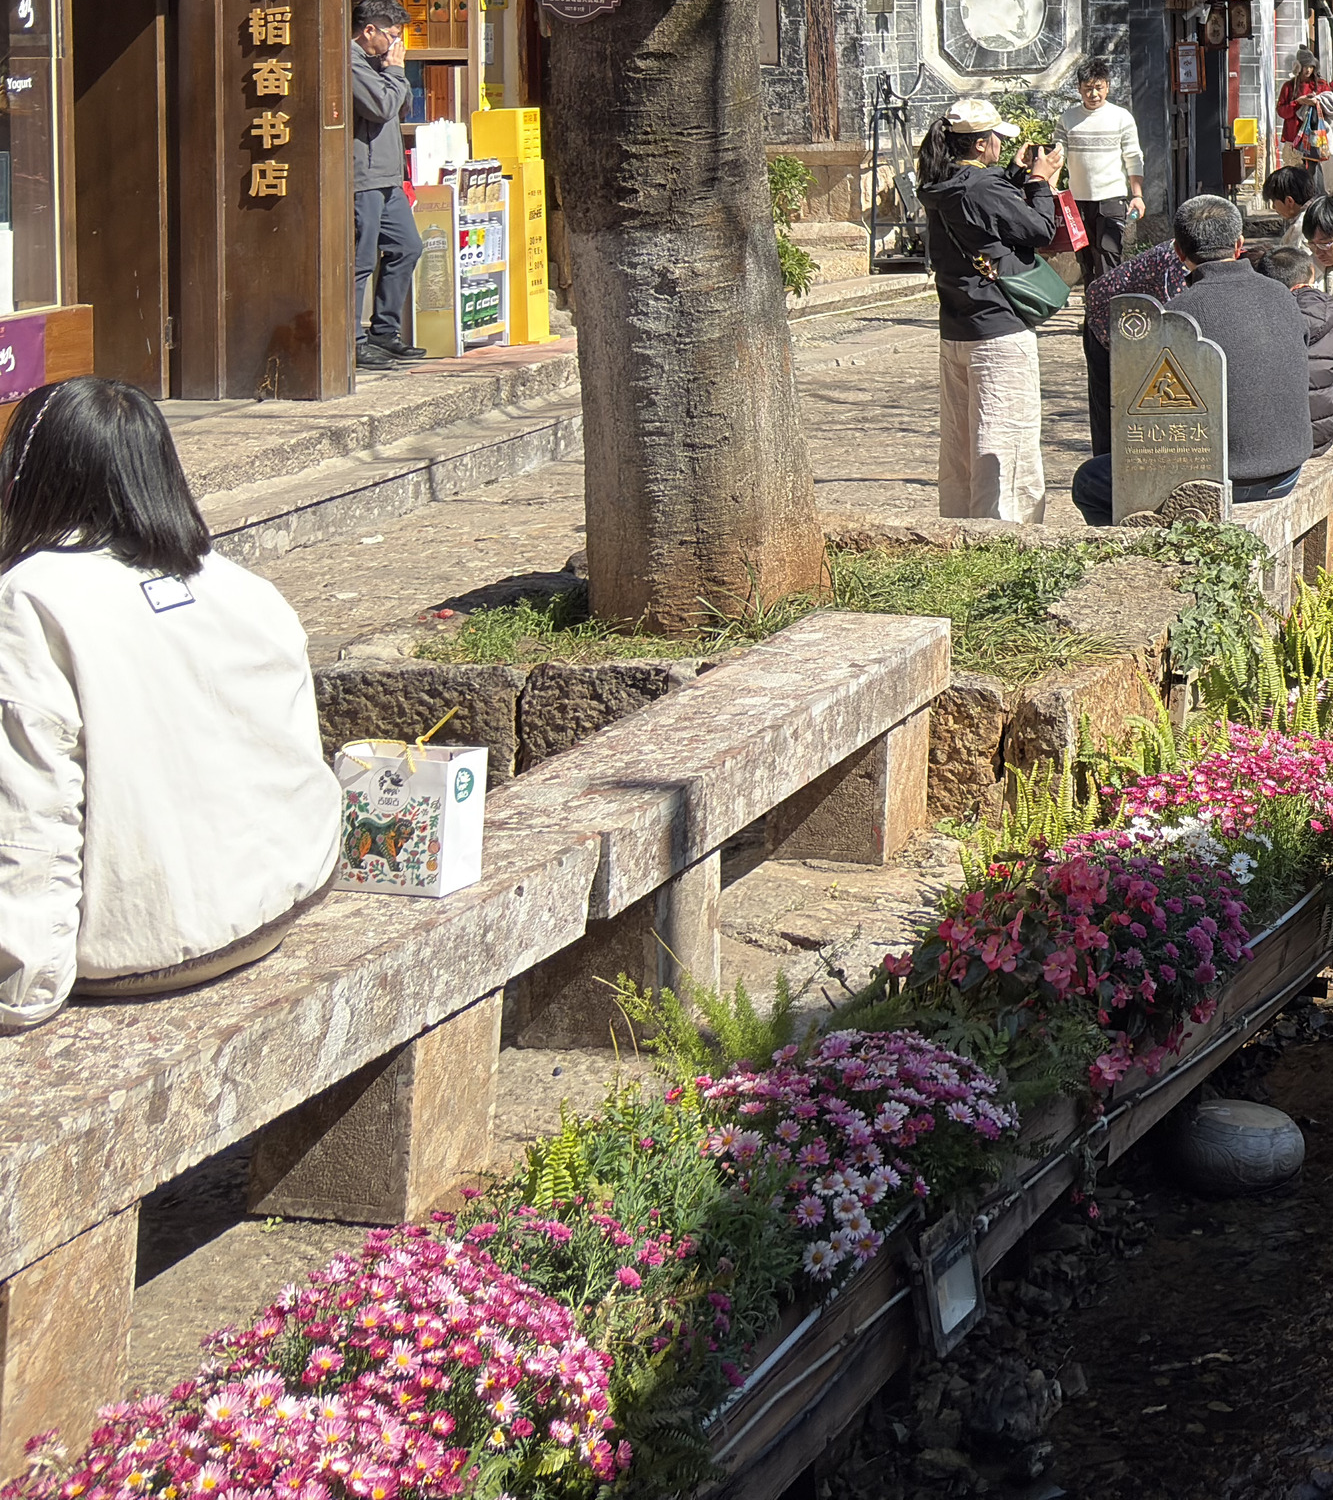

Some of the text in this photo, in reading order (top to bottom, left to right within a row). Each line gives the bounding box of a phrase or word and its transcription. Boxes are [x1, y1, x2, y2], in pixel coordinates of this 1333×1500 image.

[6, 77, 33, 92] Yogurt
[1126, 422, 1209, 443] 当心落水
